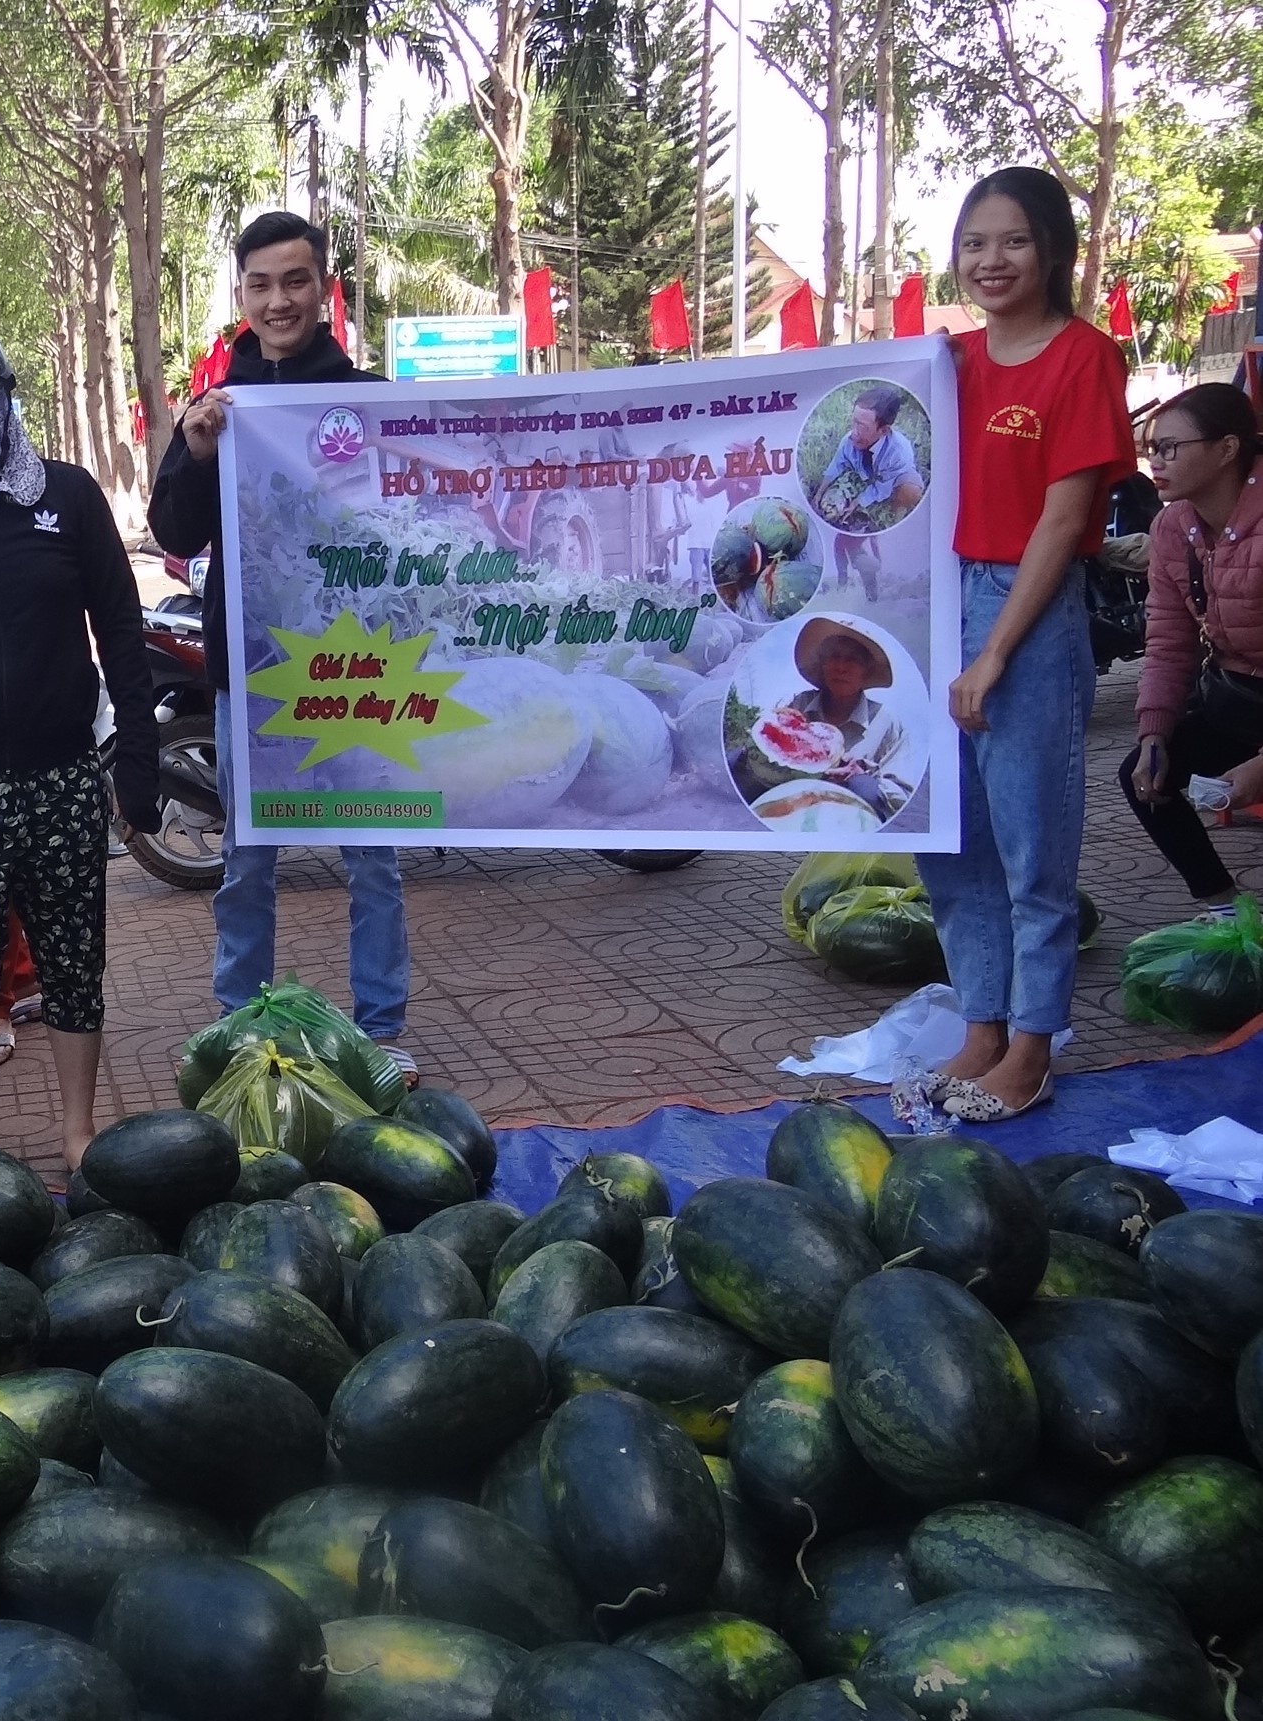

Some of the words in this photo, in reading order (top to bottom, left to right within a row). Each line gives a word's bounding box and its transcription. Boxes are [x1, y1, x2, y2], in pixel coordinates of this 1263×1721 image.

[380, 414, 437, 437] NHÓM
[440, 413, 496, 436] THIỆN
[500, 410, 577, 434] NGUYỆN
[580, 410, 624, 429] HOA
[627, 406, 664, 424] SEN
[668, 403, 692, 420] 47
[432, 466, 493, 499] TRỢ
[499, 458, 568, 492] TIÊU
[575, 459, 639, 491] THỤ
[647, 453, 717, 484] DƯA
[724, 436, 793, 479] HẤU
[34, 524, 60, 533] adidas
[393, 543, 449, 587] trái
[554, 594, 618, 644] tấm
[309, 653, 345, 681] Giá
[293, 695, 348, 720] 5000
[353, 691, 396, 725] đồng
[261, 800, 296, 817] LIÊN
[334, 803, 432, 818] 0905648909
